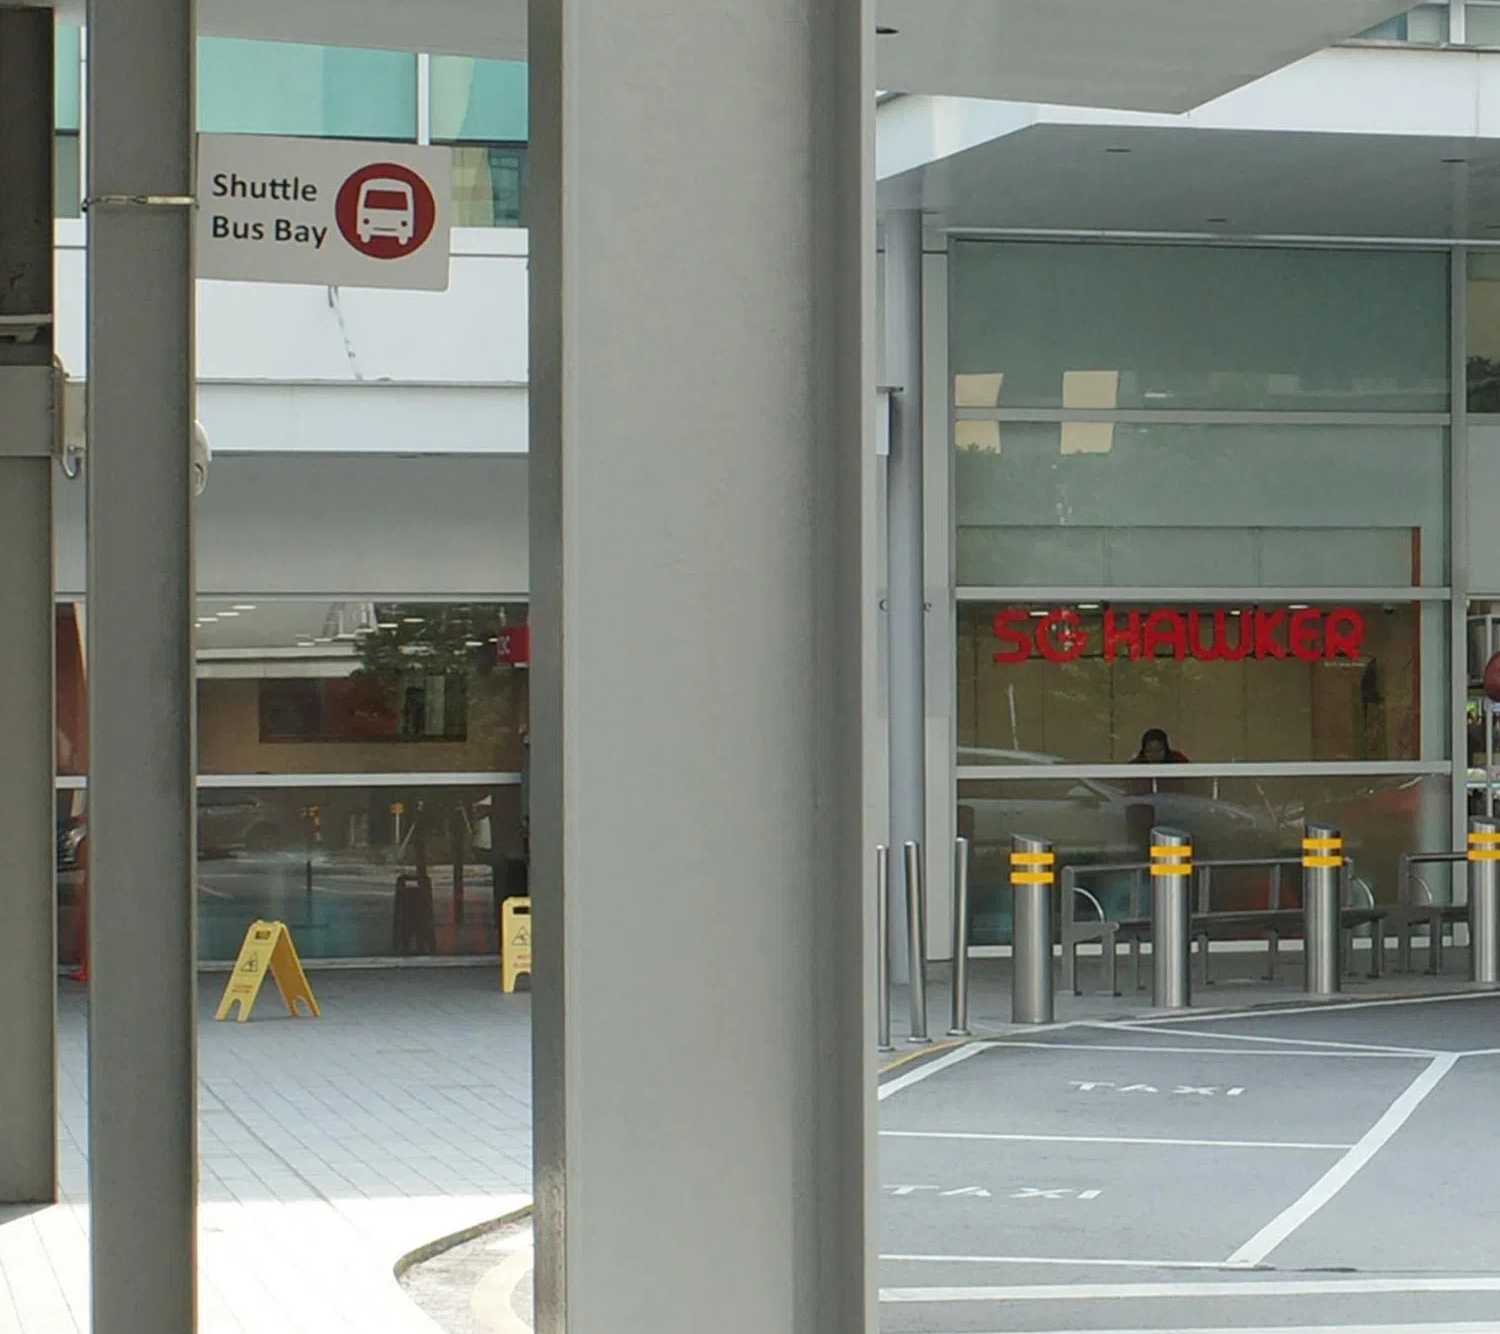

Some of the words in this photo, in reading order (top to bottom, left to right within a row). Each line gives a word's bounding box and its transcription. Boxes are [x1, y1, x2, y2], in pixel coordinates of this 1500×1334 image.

[211, 173, 318, 202] Shuttle
[211, 215, 264, 241] Bus
[274, 218, 328, 249] Bay
[992, 608, 1089, 664] SG
[1102, 607, 1367, 663] HAWKER
[1068, 1080, 1245, 1096] TAXI
[882, 1183, 1103, 1201] TAXI
